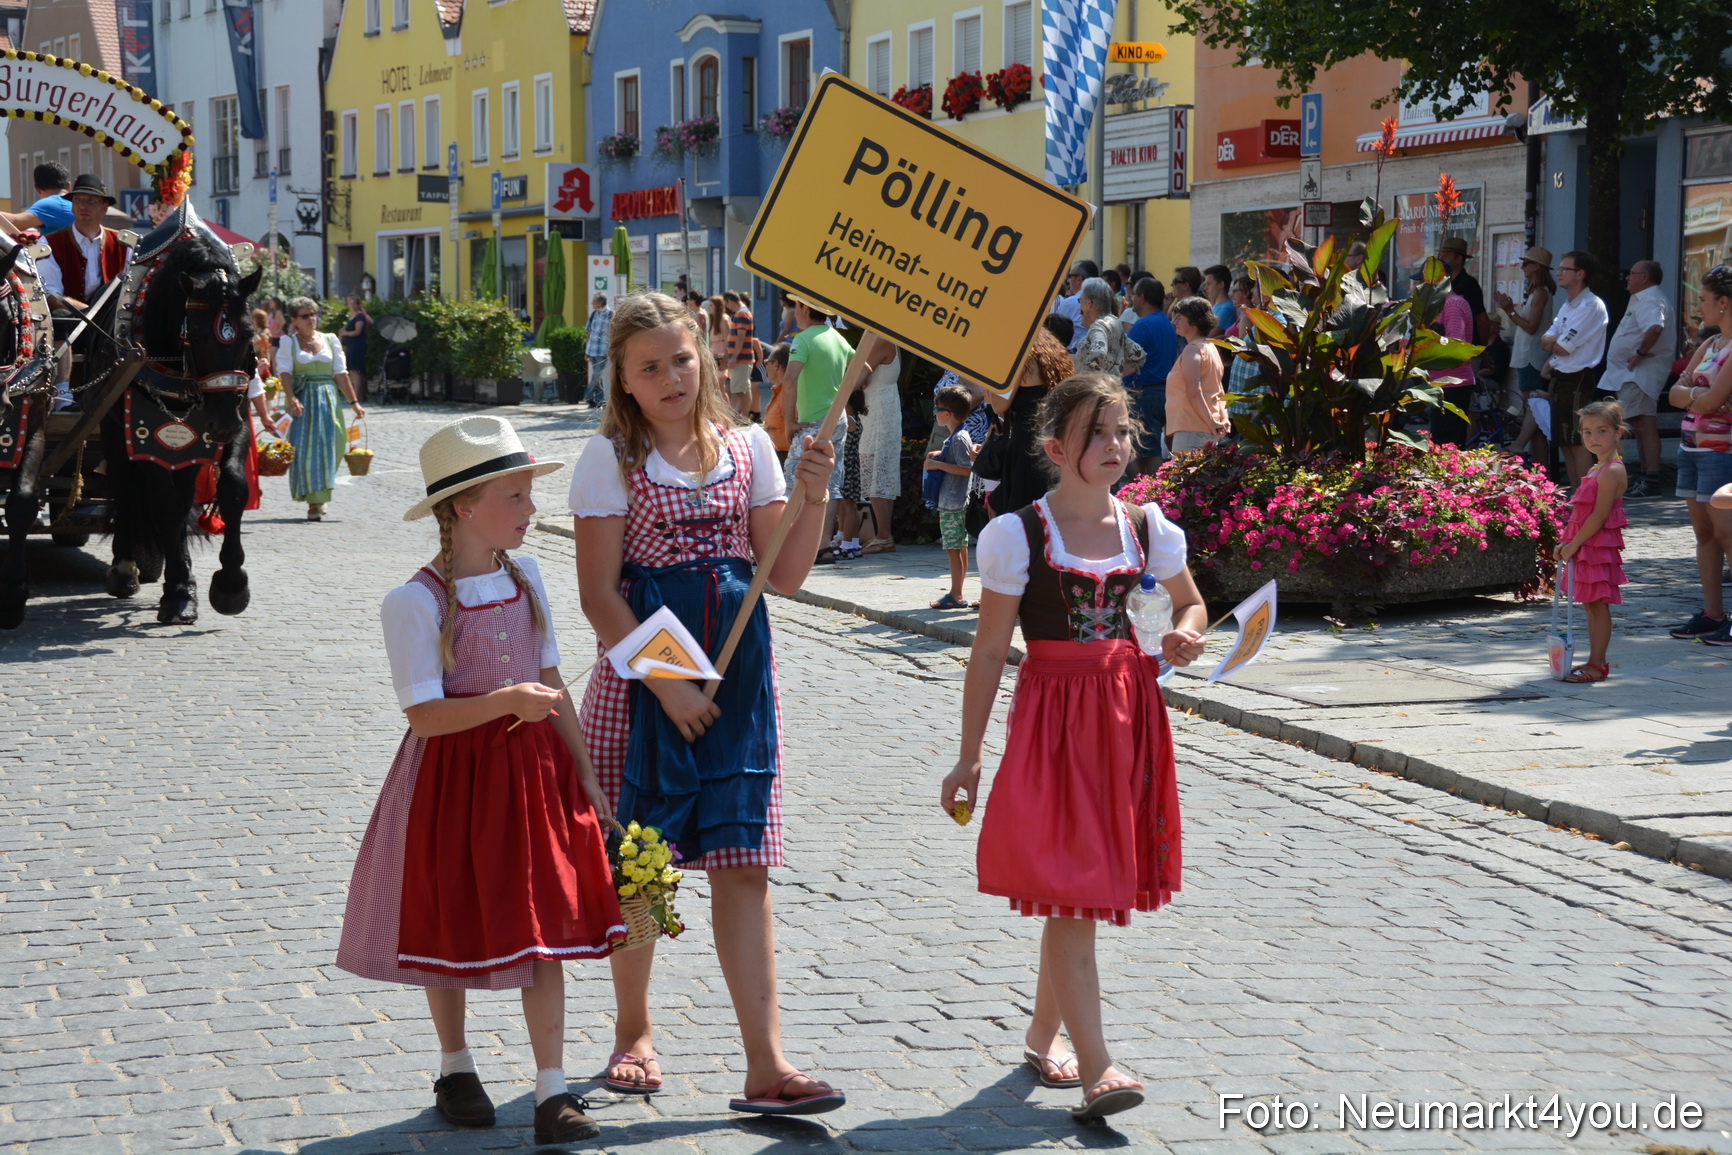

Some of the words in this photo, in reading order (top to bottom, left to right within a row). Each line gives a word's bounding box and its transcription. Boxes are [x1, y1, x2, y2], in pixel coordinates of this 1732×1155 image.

[1117, 46, 1143, 59] KINO
[382, 65, 411, 94] HOTEL
[0, 64, 165, 154] Bürgerhaus
[1305, 101, 1317, 147] P
[1173, 110, 1184, 191] KINO
[1270, 131, 1300, 146] DER
[1111, 148, 1137, 166] RIALTO
[1139, 145, 1157, 163] KINO
[1218, 144, 1235, 161] DER
[420, 192, 449, 200] TAIFU
[842, 136, 1023, 275] Pölling
[381, 204, 422, 224] Restaurant
[1401, 204, 1427, 219] MARIO
[827, 210, 931, 278] Heimat-
[936, 271, 989, 310] und
[814, 240, 972, 338] Kulturverein
